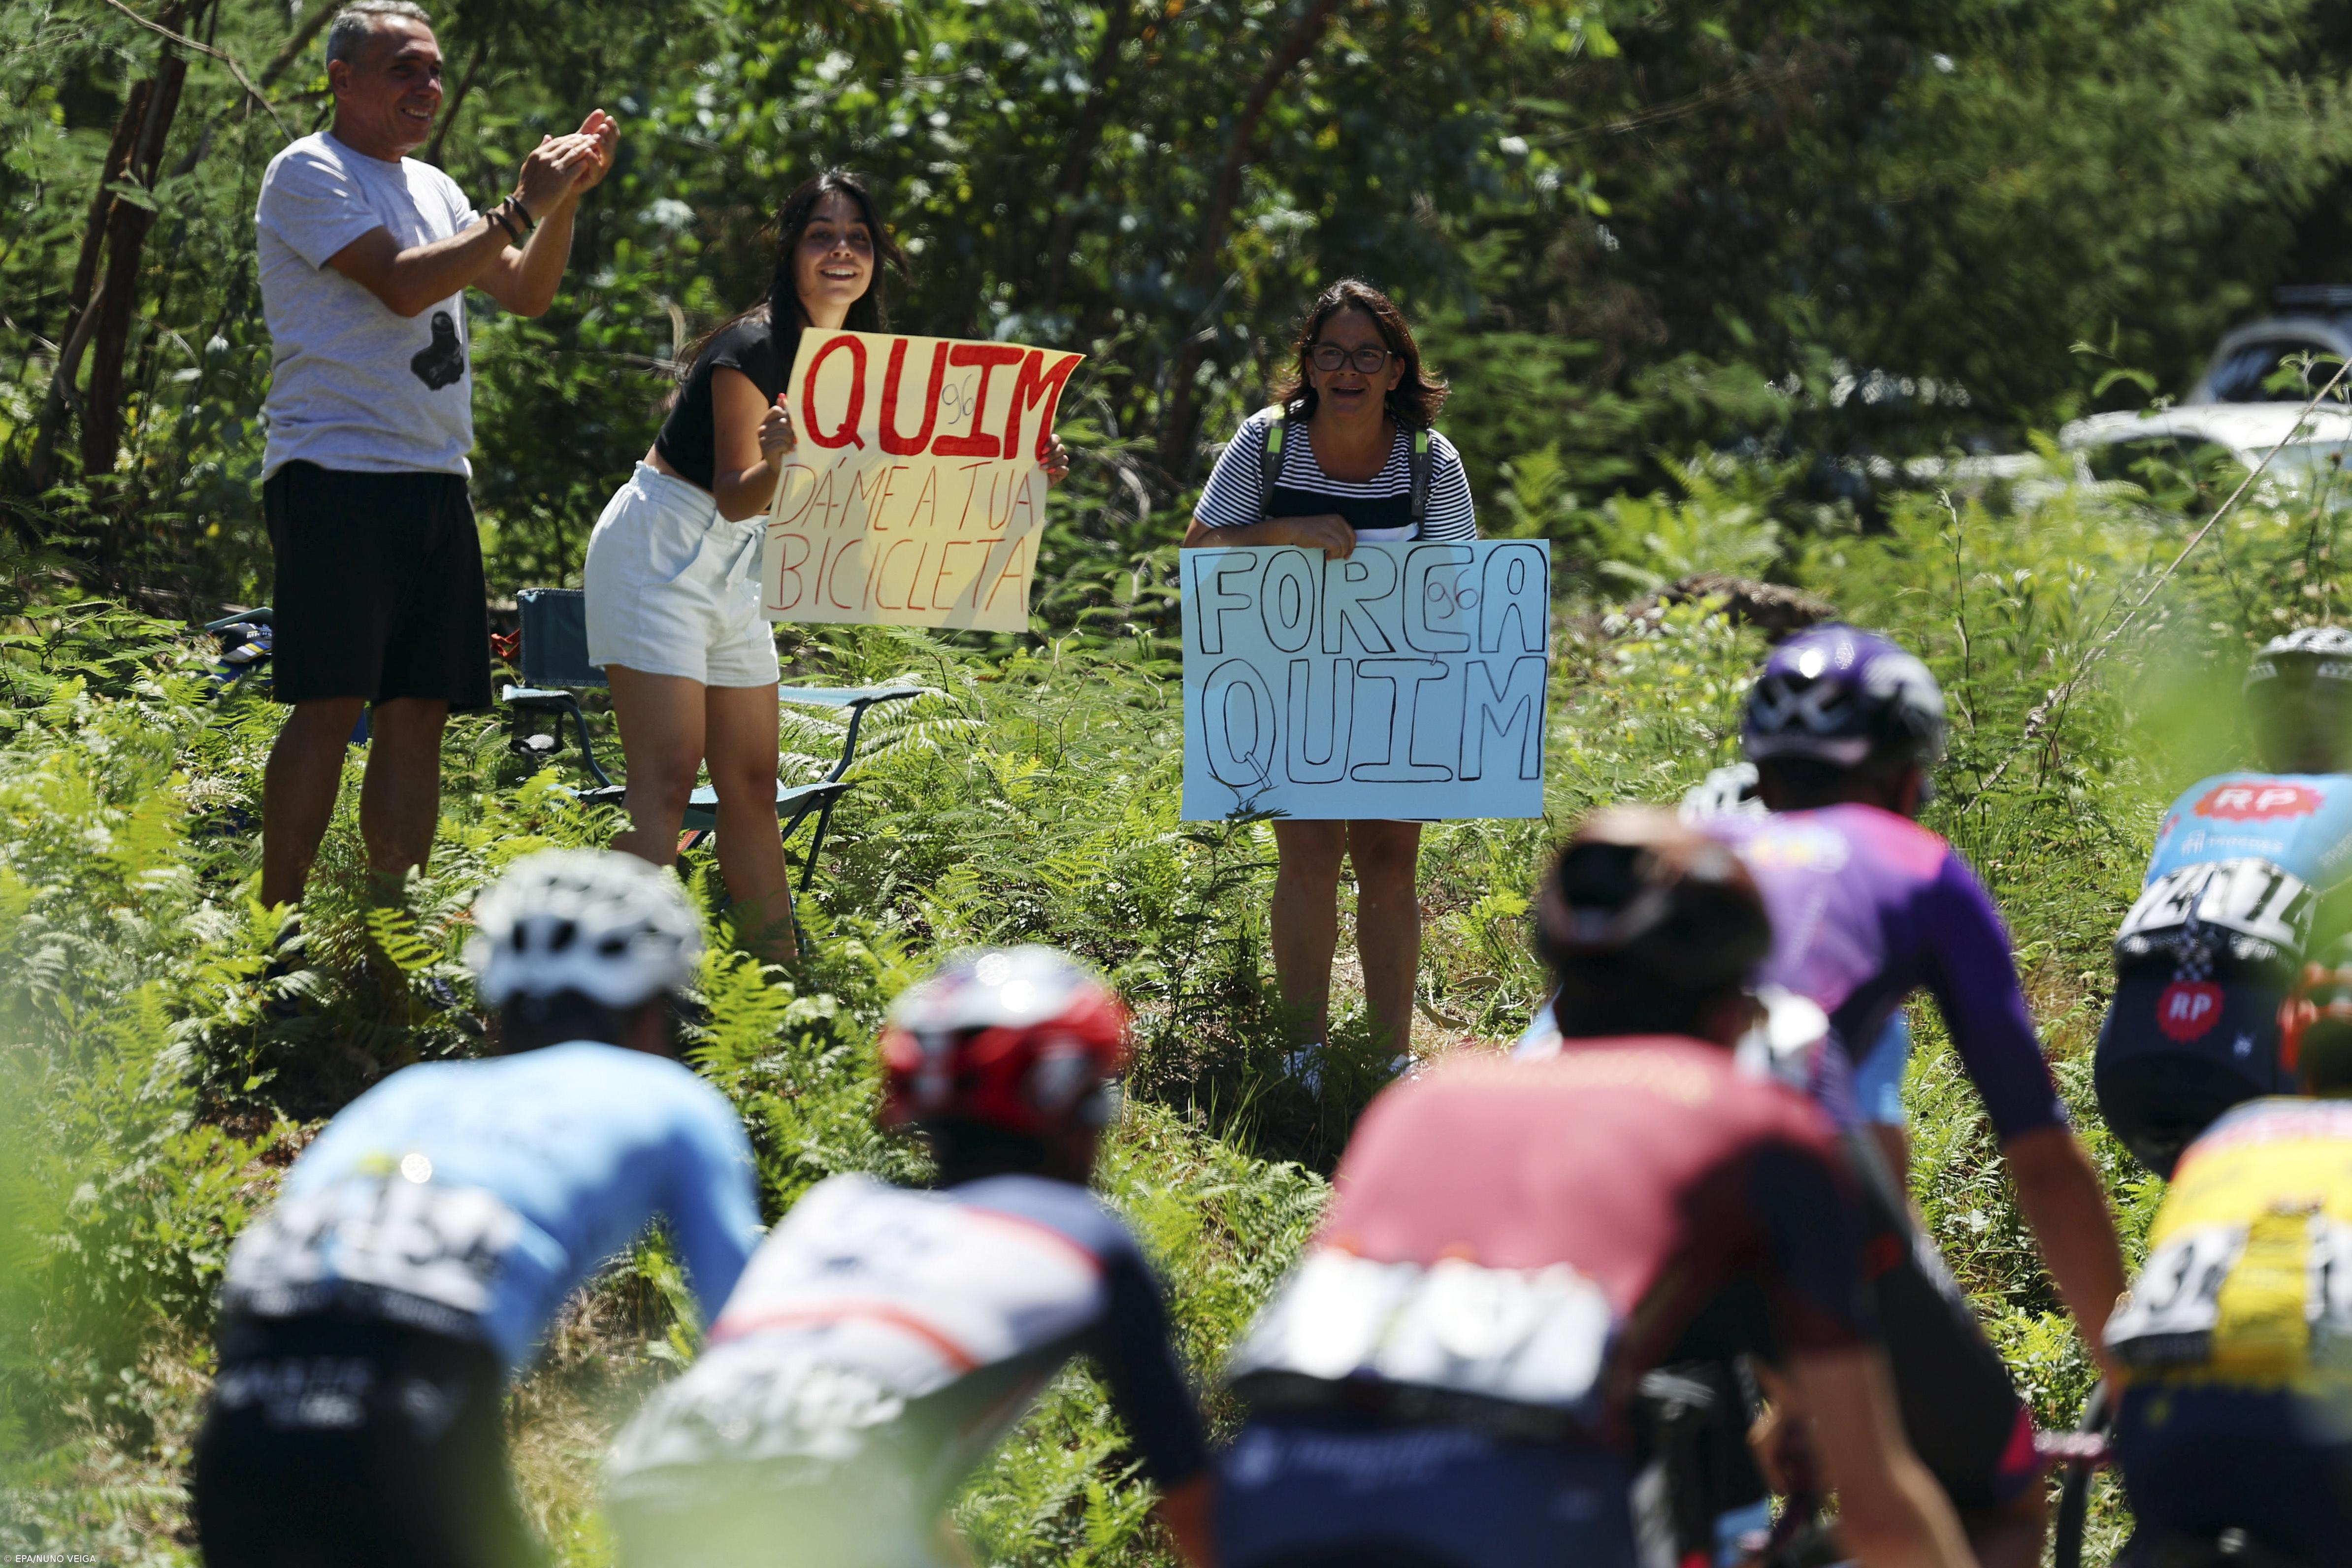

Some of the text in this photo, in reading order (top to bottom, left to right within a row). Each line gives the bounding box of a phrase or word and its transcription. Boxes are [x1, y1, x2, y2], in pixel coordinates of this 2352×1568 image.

[802, 335, 1083, 460] QUIM
[942, 373, 975, 425] 96
[908, 465, 936, 527] A
[959, 461, 1034, 530] TUA
[767, 533, 1025, 612] BICICLETA
[1193, 544, 1548, 666] FORÇA
[1427, 568, 1479, 620] 96
[1202, 655, 1548, 789] QUIM
[2214, 788, 2298, 812] RP
[2169, 992, 2213, 1021] RP
